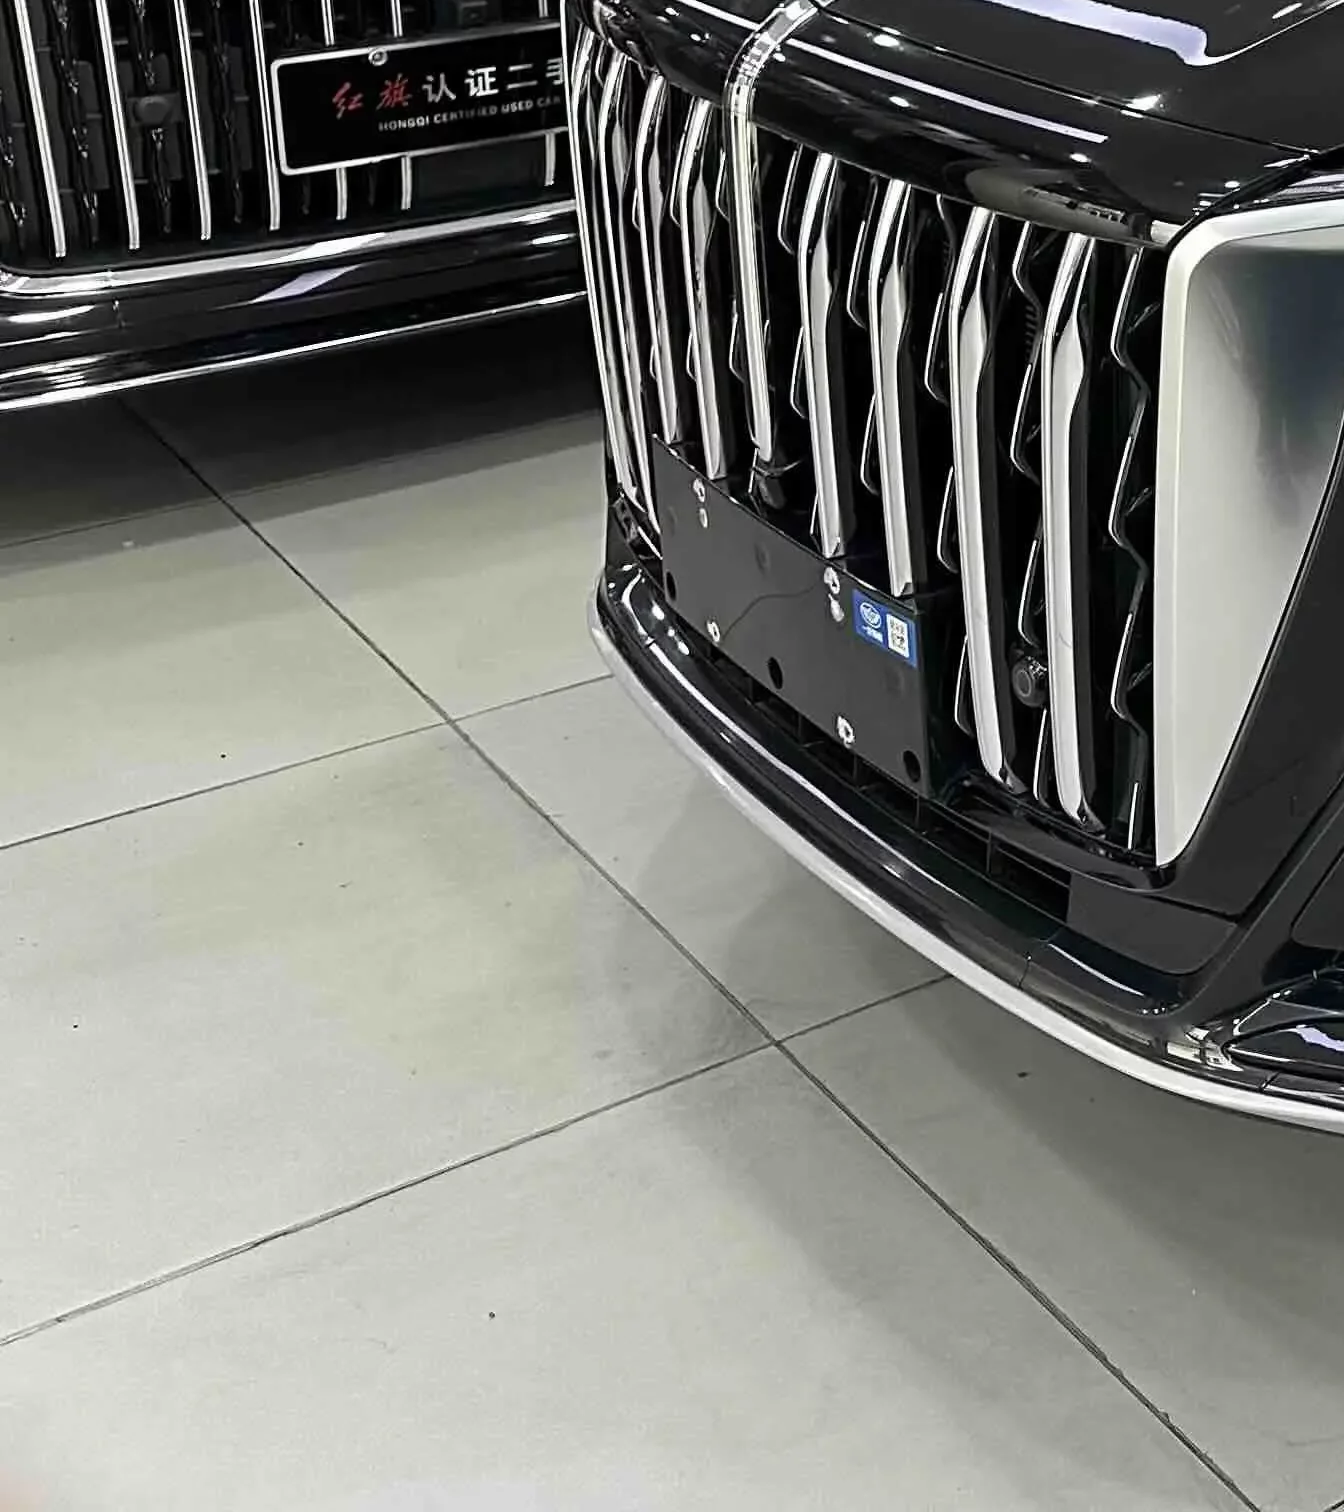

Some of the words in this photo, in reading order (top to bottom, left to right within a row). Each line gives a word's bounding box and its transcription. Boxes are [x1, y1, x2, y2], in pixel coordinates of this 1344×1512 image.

[378, 114, 430, 132] HONGQI
[433, 105, 498, 125] CERTIFIED
[501, 99, 534, 114] USED
